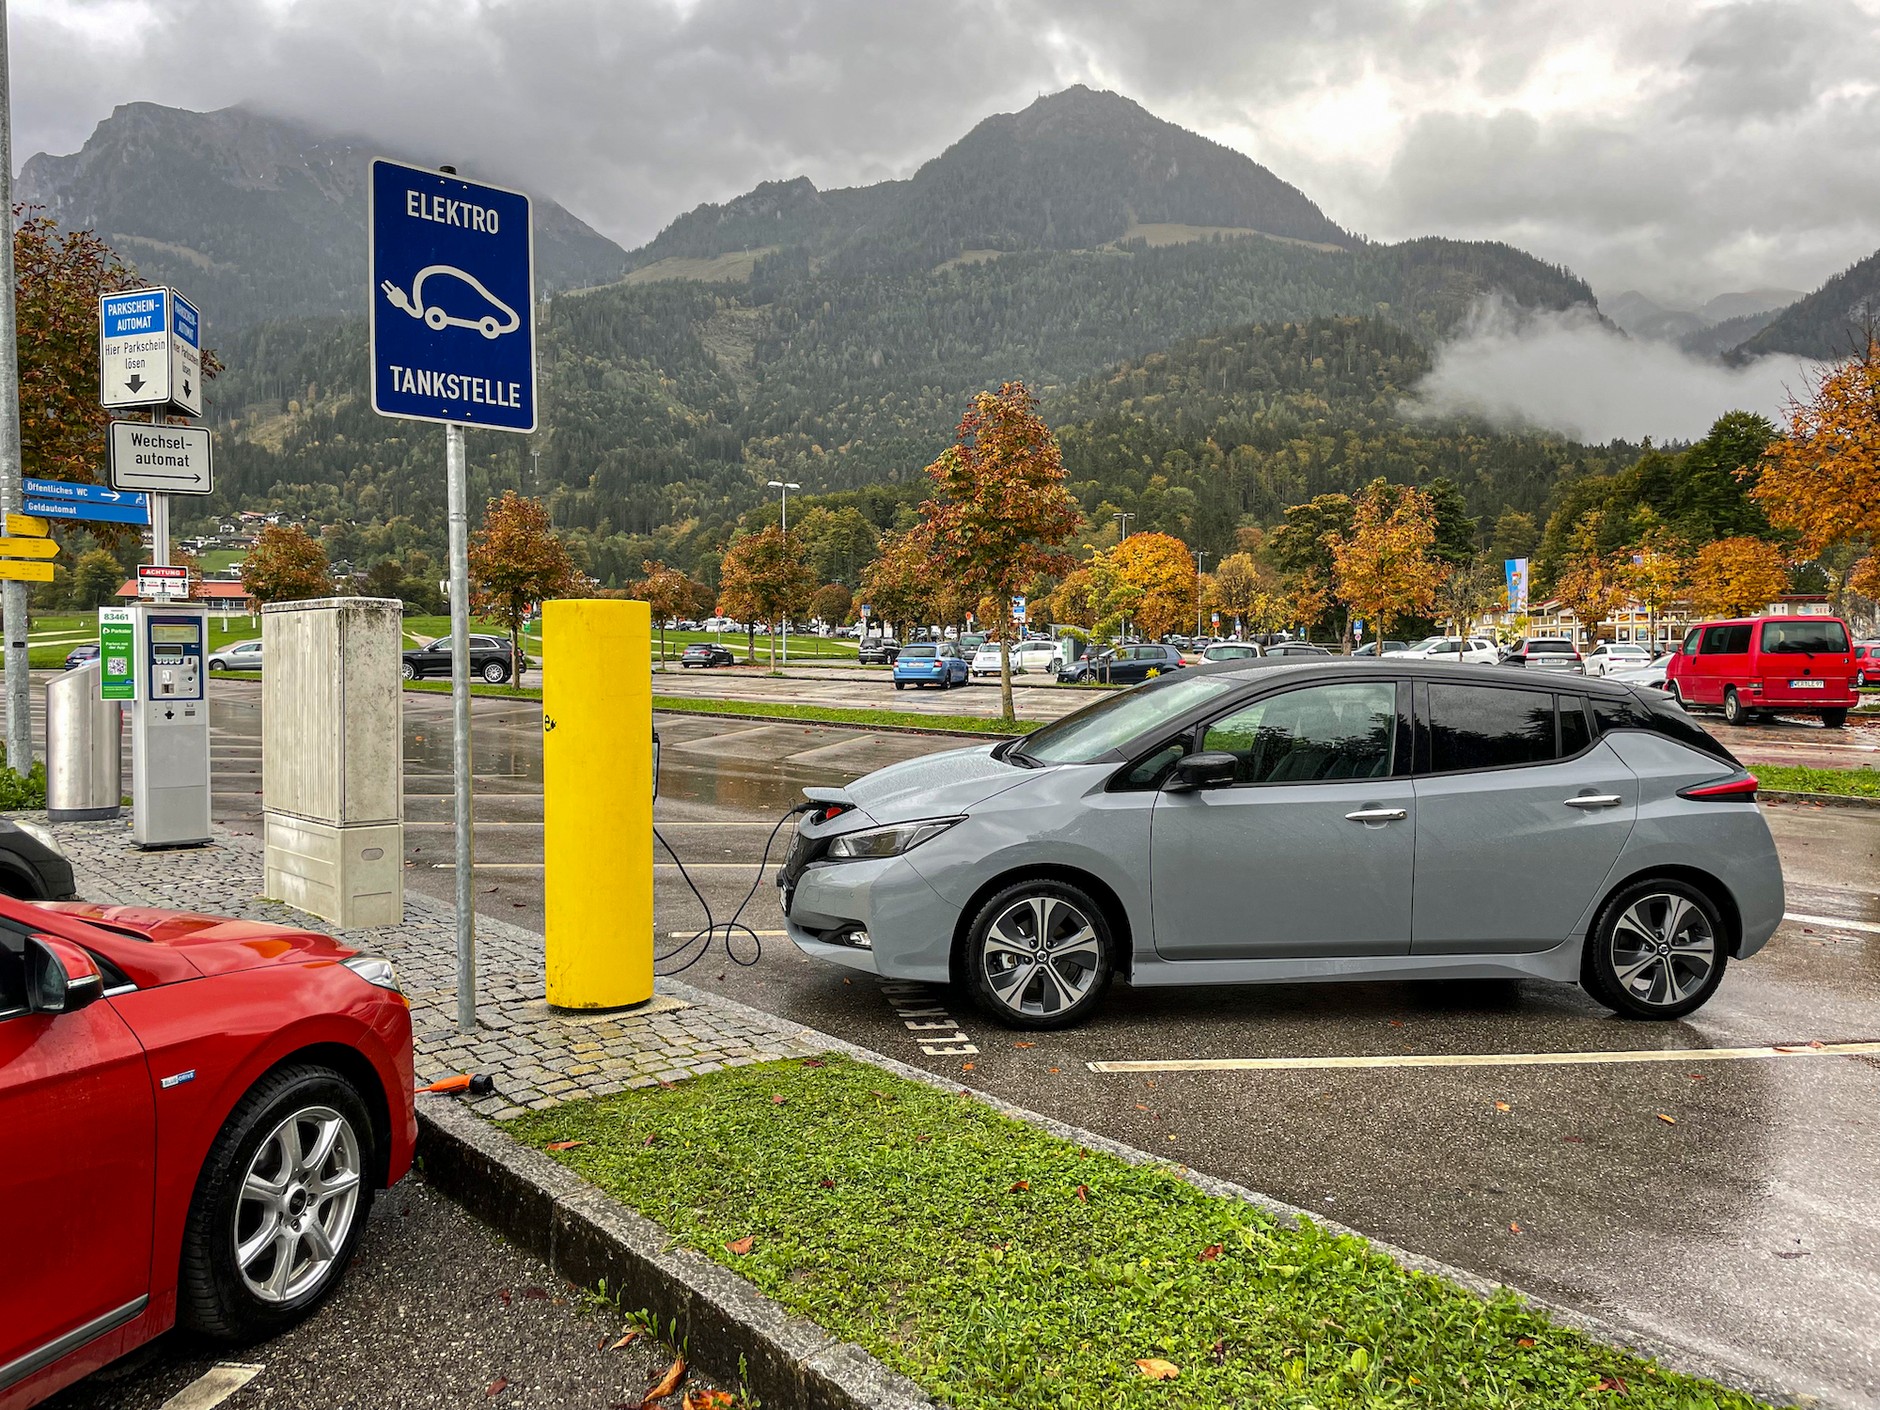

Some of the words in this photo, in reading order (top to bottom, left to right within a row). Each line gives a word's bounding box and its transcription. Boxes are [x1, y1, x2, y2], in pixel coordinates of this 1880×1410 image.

[407, 189, 499, 235] ELEKTRO
[108, 299, 160, 316] PARKSCHEIN-
[117, 315, 152, 332] AUTOMAT
[105, 343, 120, 356] Hier
[124, 338, 166, 354] Parkschein
[125, 357, 146, 370] lösen
[390, 365, 521, 409] TANKSTELLE
[131, 432, 193, 450] Wechsel-
[135, 452, 190, 467] automat
[27, 481, 73, 495] Öffentliches
[76, 487, 88, 497] WC
[28, 502, 77, 515] Geldautomat
[103, 613, 129, 621] 83461
